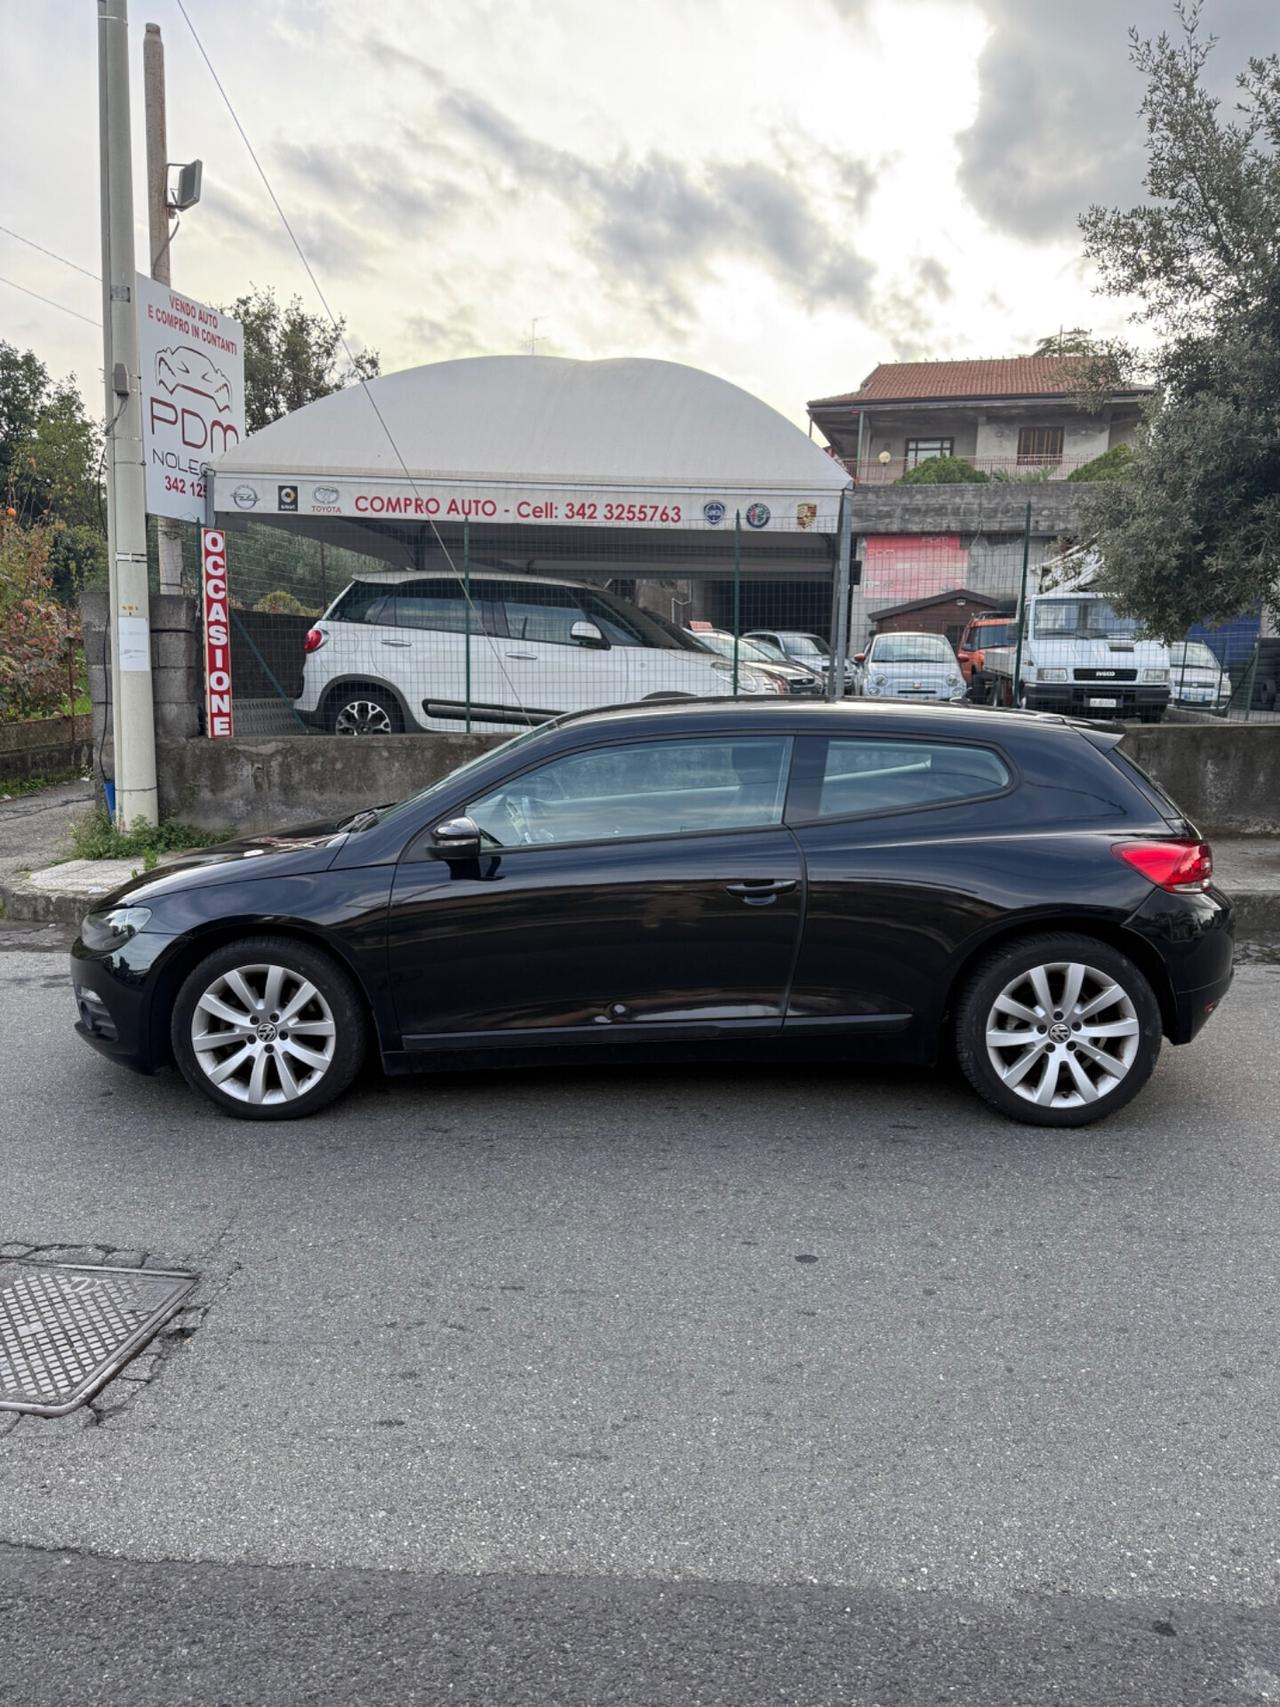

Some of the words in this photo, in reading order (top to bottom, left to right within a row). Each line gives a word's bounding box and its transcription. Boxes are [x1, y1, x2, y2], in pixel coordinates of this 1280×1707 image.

[169, 295, 197, 319] VENDO
[198, 309, 218, 329] AUTO
[147, 303, 154, 319] E
[156, 307, 190, 334] COMPRO
[191, 323, 200, 339] IN
[201, 329, 237, 356] CONTANTI
[165, 475, 186, 494] 342
[311, 505, 342, 514] TOYOTA
[355, 496, 440, 514] COMPRO
[447, 499, 497, 516] AUTO
[517, 501, 558, 518] Cell:
[565, 502, 597, 519] 342
[603, 503, 682, 523] 3255763
[205, 531, 230, 736] OCCASIONE
